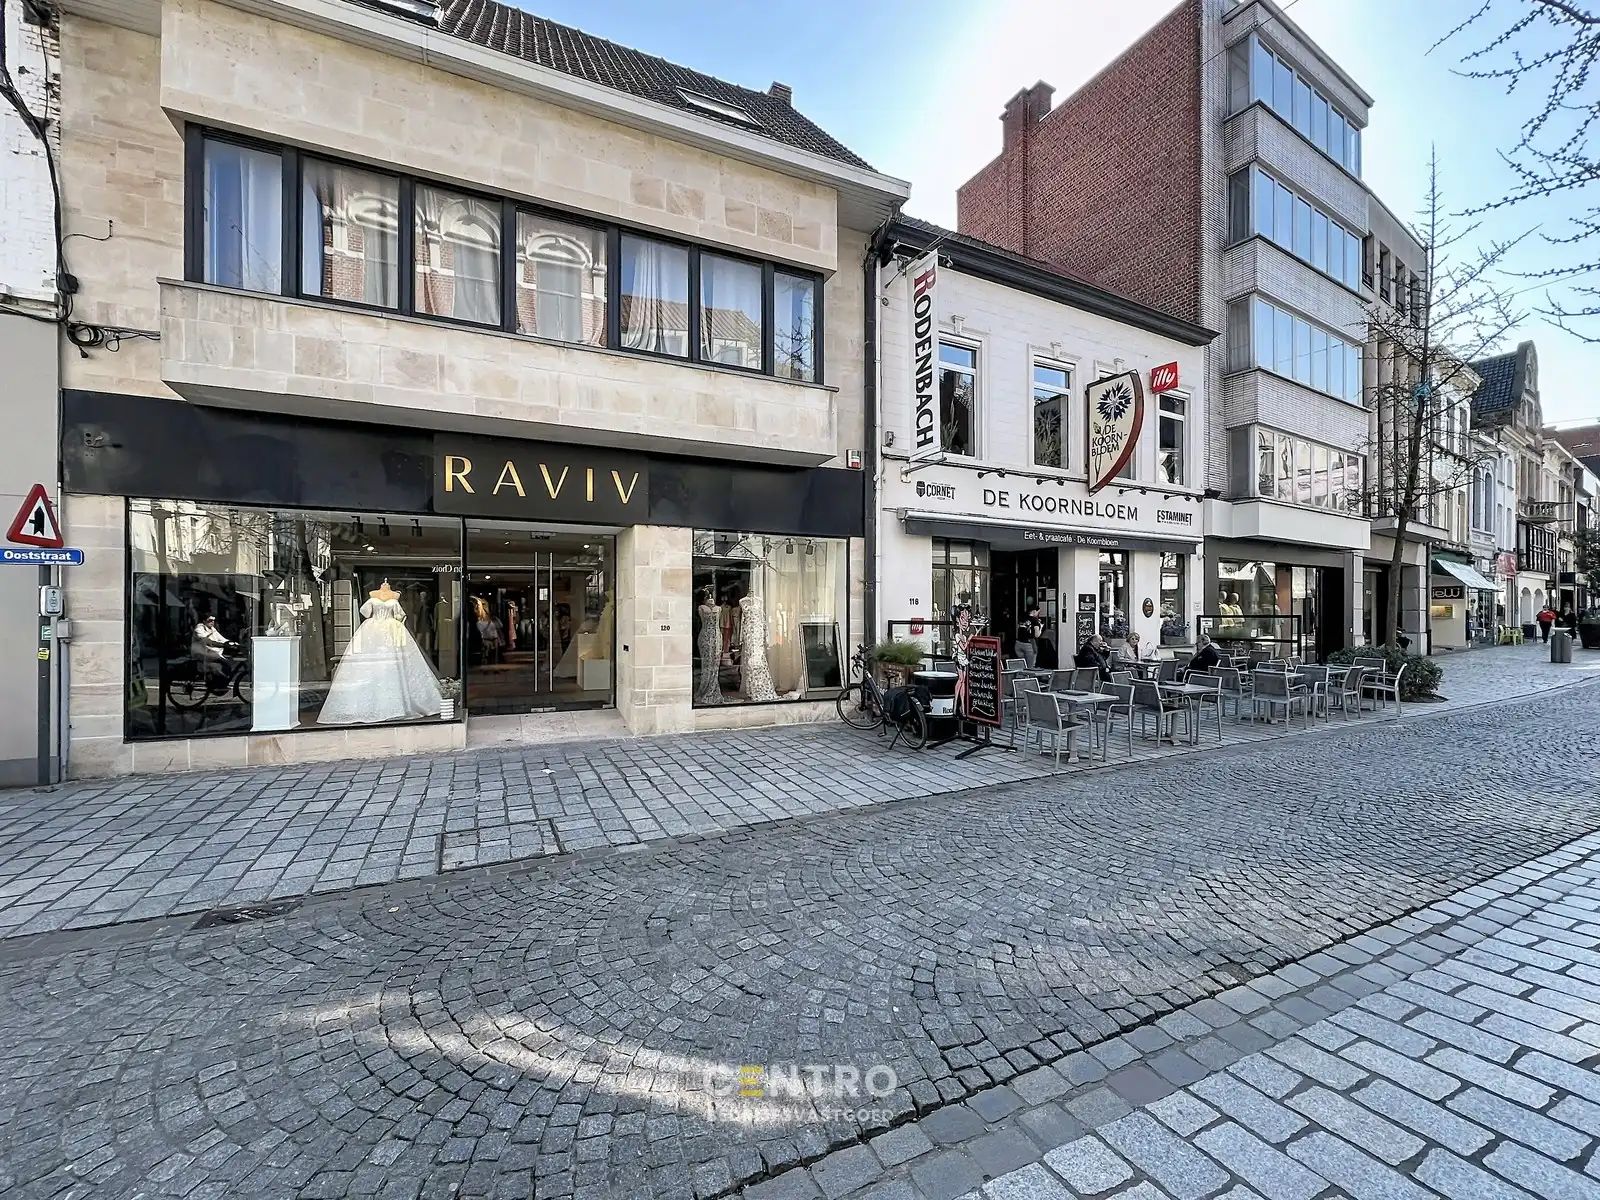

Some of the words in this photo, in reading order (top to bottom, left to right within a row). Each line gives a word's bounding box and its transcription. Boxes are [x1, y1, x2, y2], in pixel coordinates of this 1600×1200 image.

[913, 263, 937, 449] RODENBACH
[1153, 368, 1176, 388] illy
[1103, 424, 1116, 435] DE
[1092, 432, 1128, 447] KOORN-
[1091, 443, 1119, 457] BLOEM
[444, 455, 639, 504] RAVIV
[926, 484, 956, 500] CORNET
[983, 489, 1010, 508] DE
[1019, 493, 1138, 521] KOORNBLOEM
[1157, 510, 1193, 526] ESTAMINET
[1024, 531, 1038, 540] Eet-
[1038, 532, 1044, 541] &
[1045, 534, 1073, 543] praatcafé
[1077, 536, 1086, 544] De
[1087, 537, 1119, 546] Koornbloem
[4, 550, 71, 560] Ooststraat
